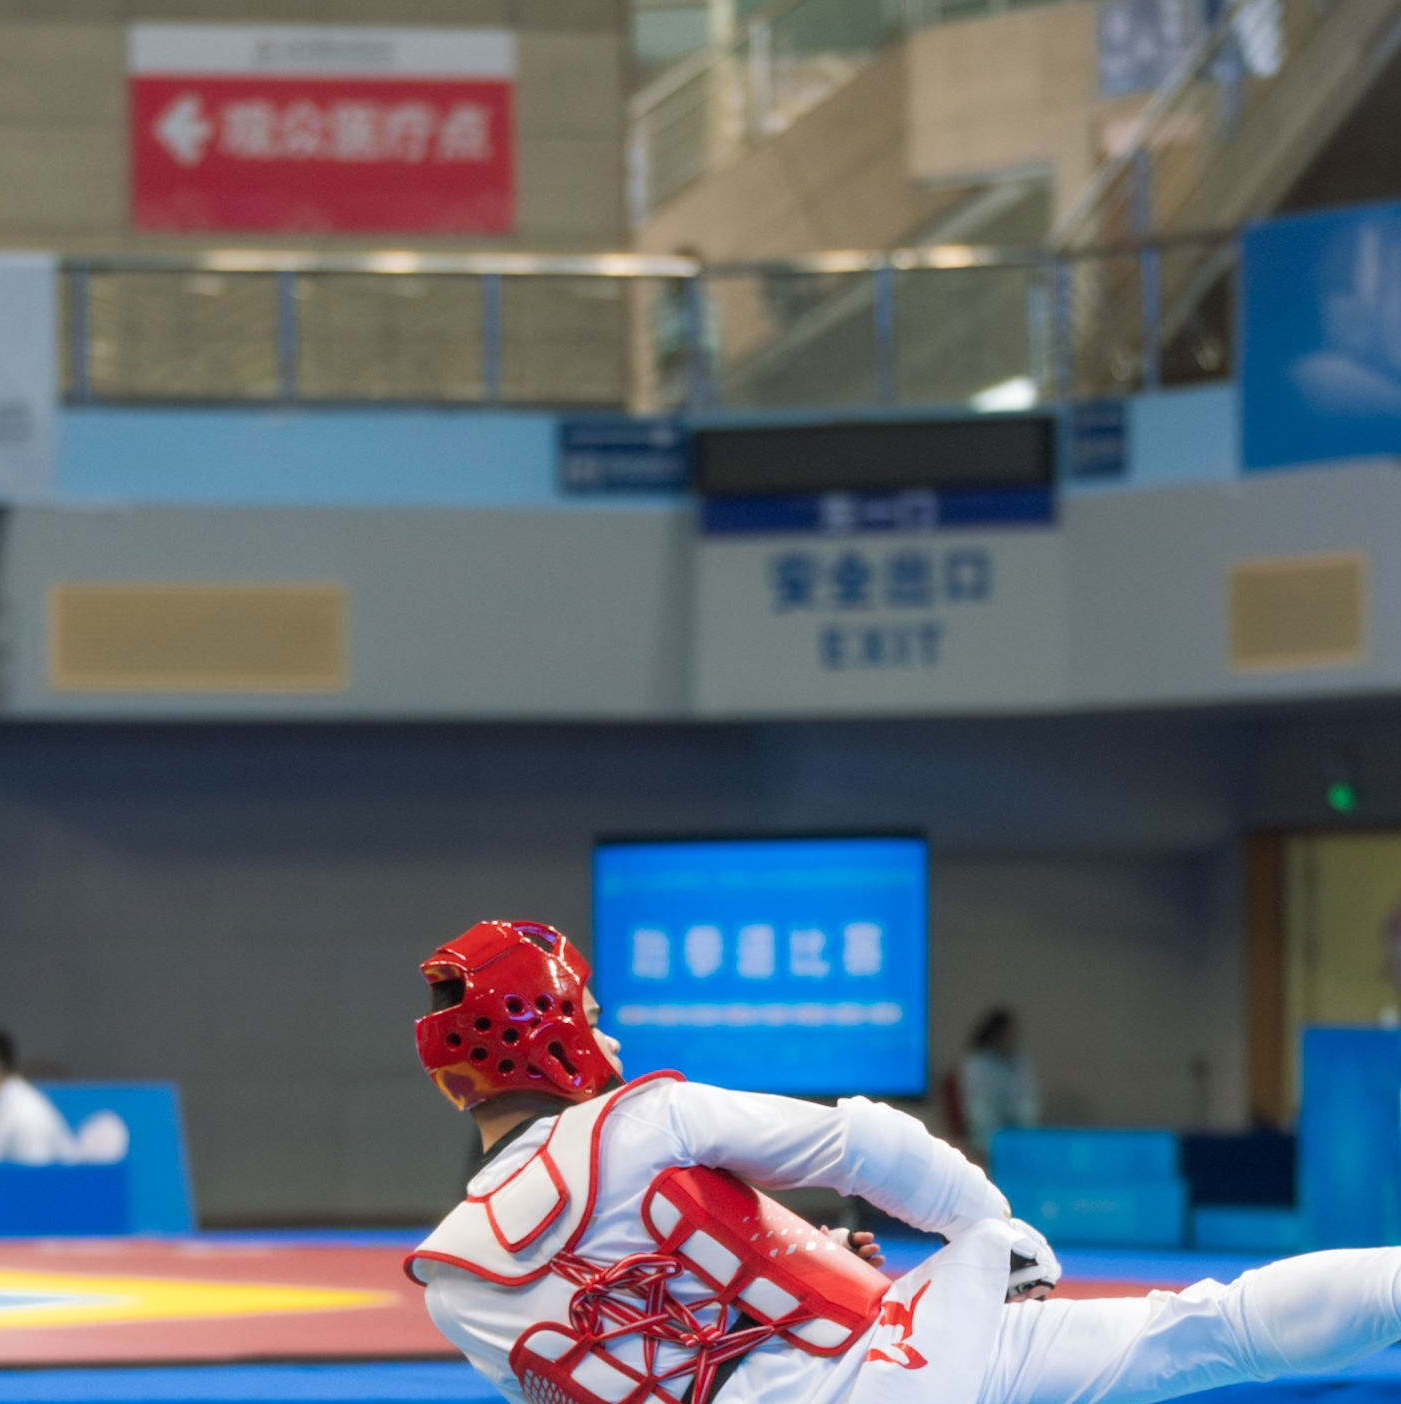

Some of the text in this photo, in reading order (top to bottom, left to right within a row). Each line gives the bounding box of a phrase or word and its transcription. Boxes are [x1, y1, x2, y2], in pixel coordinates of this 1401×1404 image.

[769, 547, 992, 614] 安全出口
[819, 619, 945, 672] EXIT
